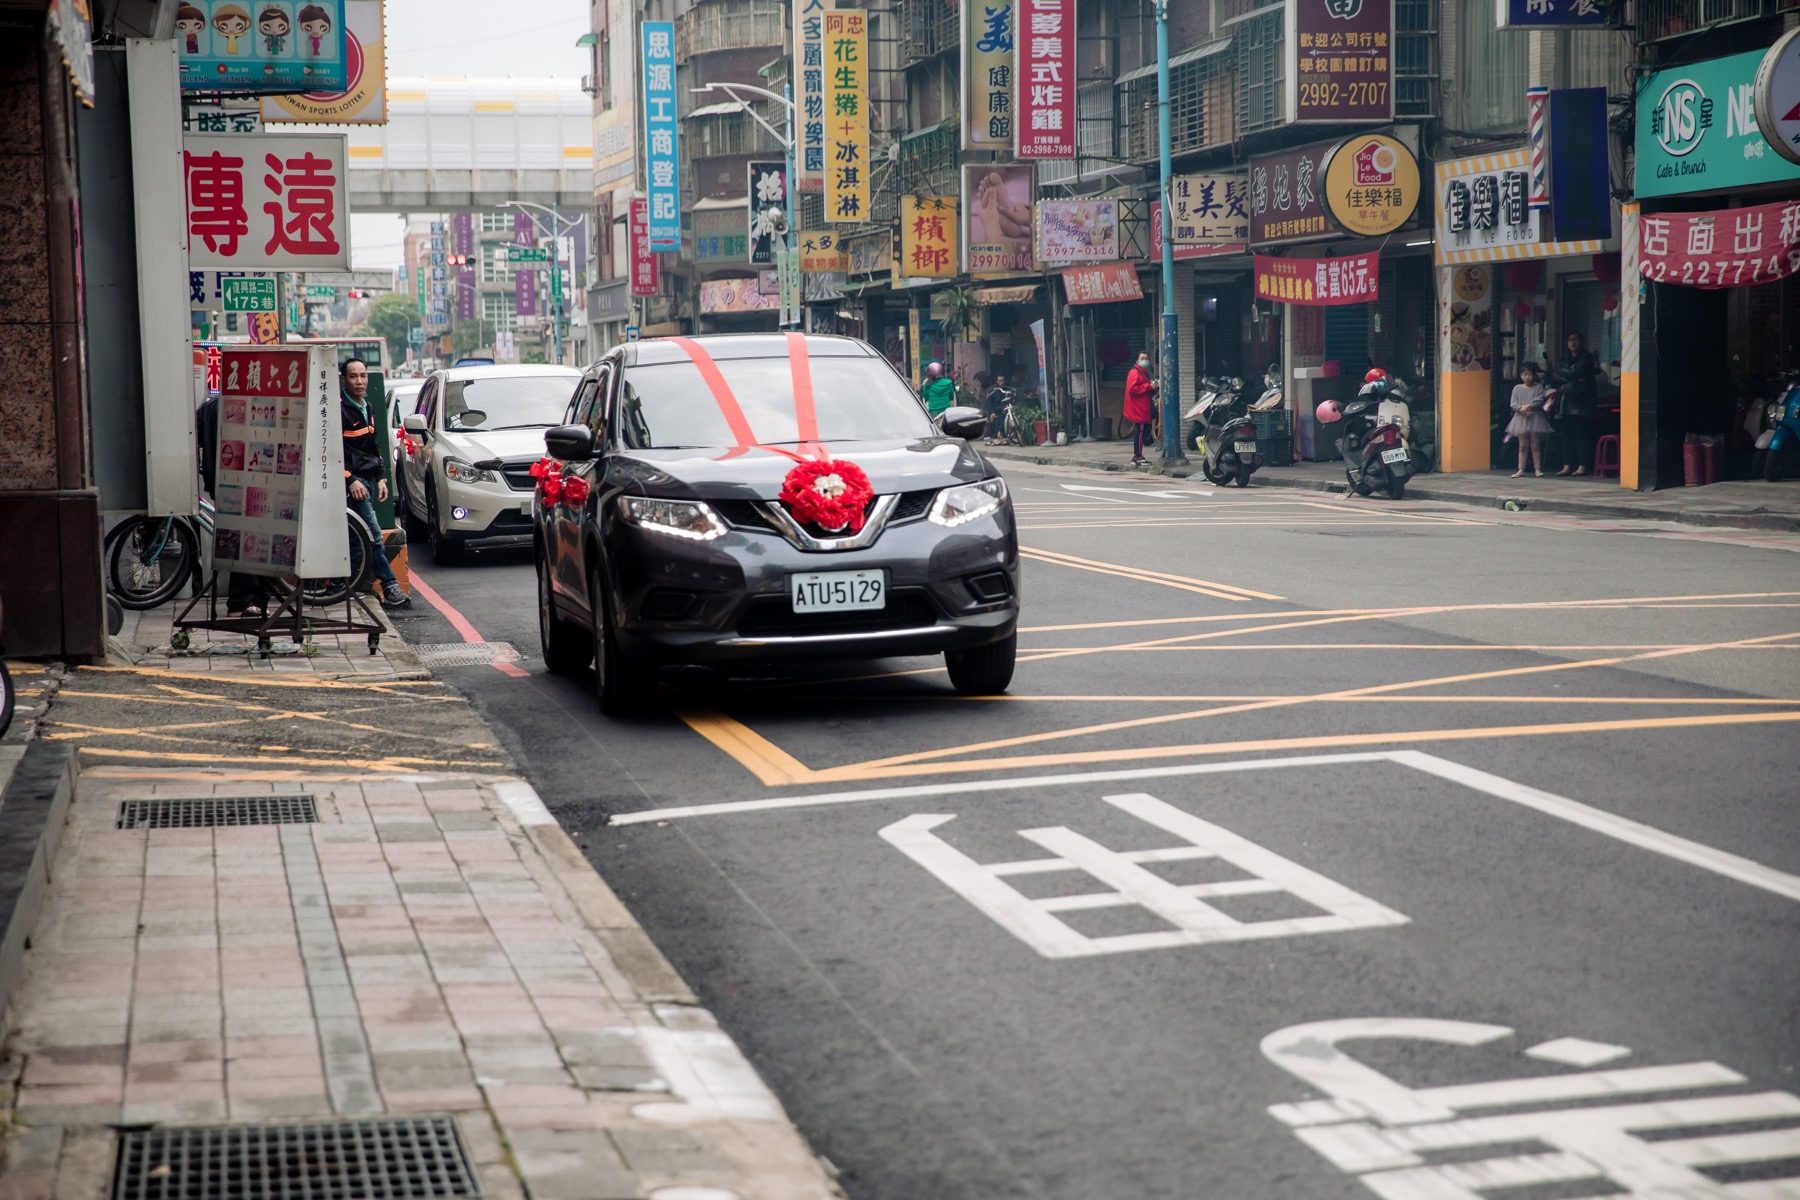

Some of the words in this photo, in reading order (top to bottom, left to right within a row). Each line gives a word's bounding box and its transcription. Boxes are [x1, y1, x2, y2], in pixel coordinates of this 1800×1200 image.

[827, 15, 864, 35] 阿忠
[1300, 32, 1388, 48] 歡迎公司行號
[1300, 82, 1388, 106] 2992-2707
[648, 32, 676, 220] 思源工商登記
[1360, 163, 1371, 171] Le
[1681, 160, 1707, 177] Brunch
[1360, 173, 1382, 182] Food
[1345, 188, 1402, 208] 佳樂福
[1445, 171, 1525, 233] 佳樂福
[1506, 229, 1533, 241] FOOD
[1046, 246, 1114, 256] 2997-0116
[971, 254, 1032, 268] 29970116
[232, 281, 274, 294] 復興路二段
